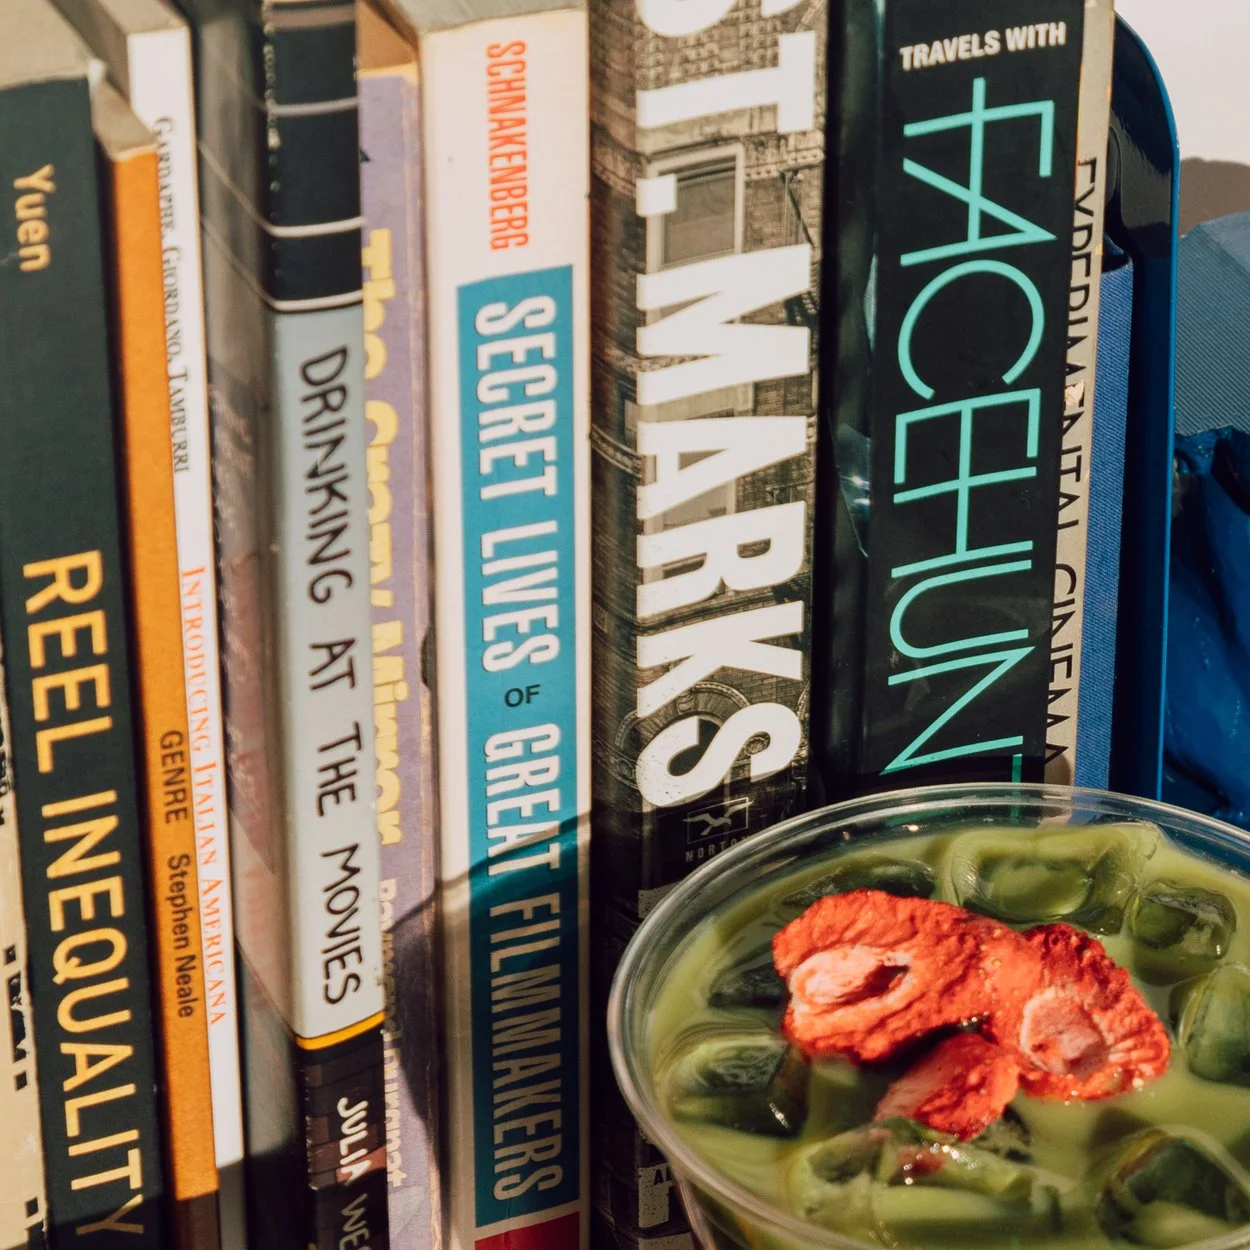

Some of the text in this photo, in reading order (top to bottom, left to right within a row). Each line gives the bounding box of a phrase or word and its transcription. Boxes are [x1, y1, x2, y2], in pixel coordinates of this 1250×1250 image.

[900, 22, 1066, 71] TRAVELS WITH
[13, 163, 55, 272] Yuen
[486, 39, 529, 251] SCHNAKENBERG
[168, 368, 191, 474] TAMBURRI
[884, 76, 1056, 812] FACEHUN
[636, 244, 810, 808] MARKS
[301, 346, 363, 1005] DRINKING AT THE MOVIES
[474, 295, 563, 1201] SECRET LIVES OF GREAT FILMMAKERS
[159, 730, 189, 826] GENRE
[179, 566, 227, 1026] INTRODUCING ITALIAN AMERICANA
[684, 834, 750, 863] NORT
[23, 549, 146, 1236] REEL INEQUALITY
[167, 852, 195, 1020] Stephen Neale
[338, 1096, 369, 1186] JULIA
